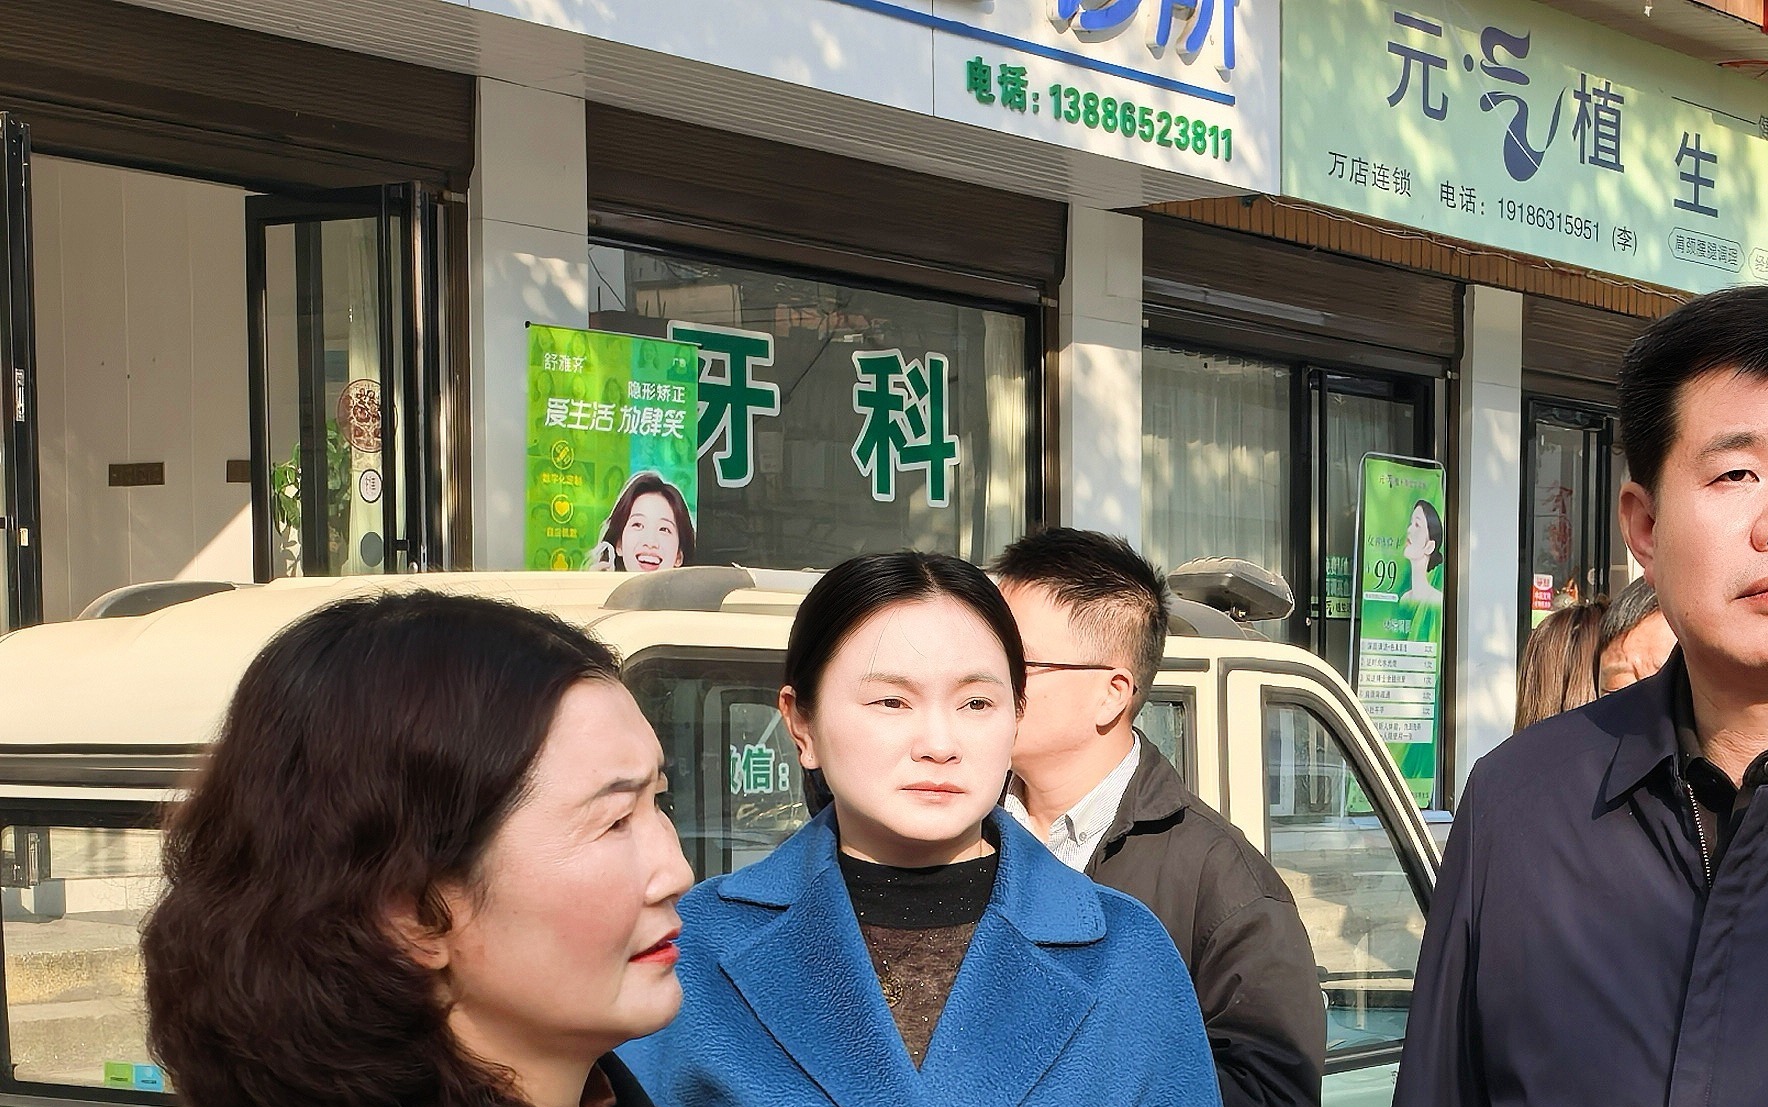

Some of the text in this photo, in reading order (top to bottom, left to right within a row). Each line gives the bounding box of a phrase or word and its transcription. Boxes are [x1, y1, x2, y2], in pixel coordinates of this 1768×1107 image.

[1327, 151, 1412, 198] 万店连锁
[544, 352, 585, 374] 舒雅齐
[628, 381, 686, 404] 隐形矫正
[545, 397, 687, 439] 爱生活 放肆笑
[668, 320, 960, 508] 牙科
